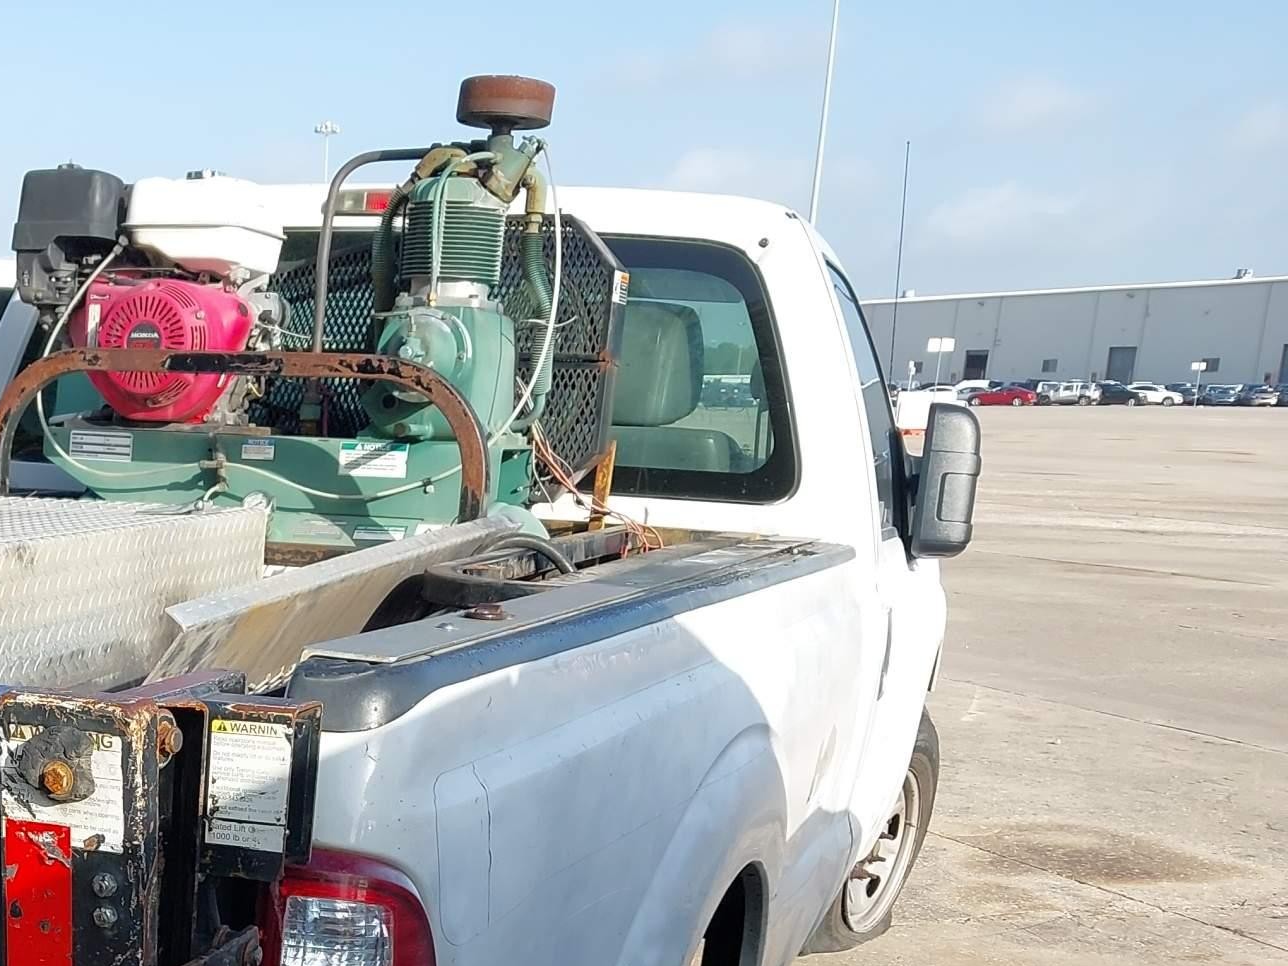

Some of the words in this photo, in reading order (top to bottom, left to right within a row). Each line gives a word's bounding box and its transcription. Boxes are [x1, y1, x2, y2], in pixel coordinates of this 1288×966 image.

[130, 331, 160, 339] HONDA
[229, 722, 278, 736] WARNIN
[212, 832, 231, 841] 1000
